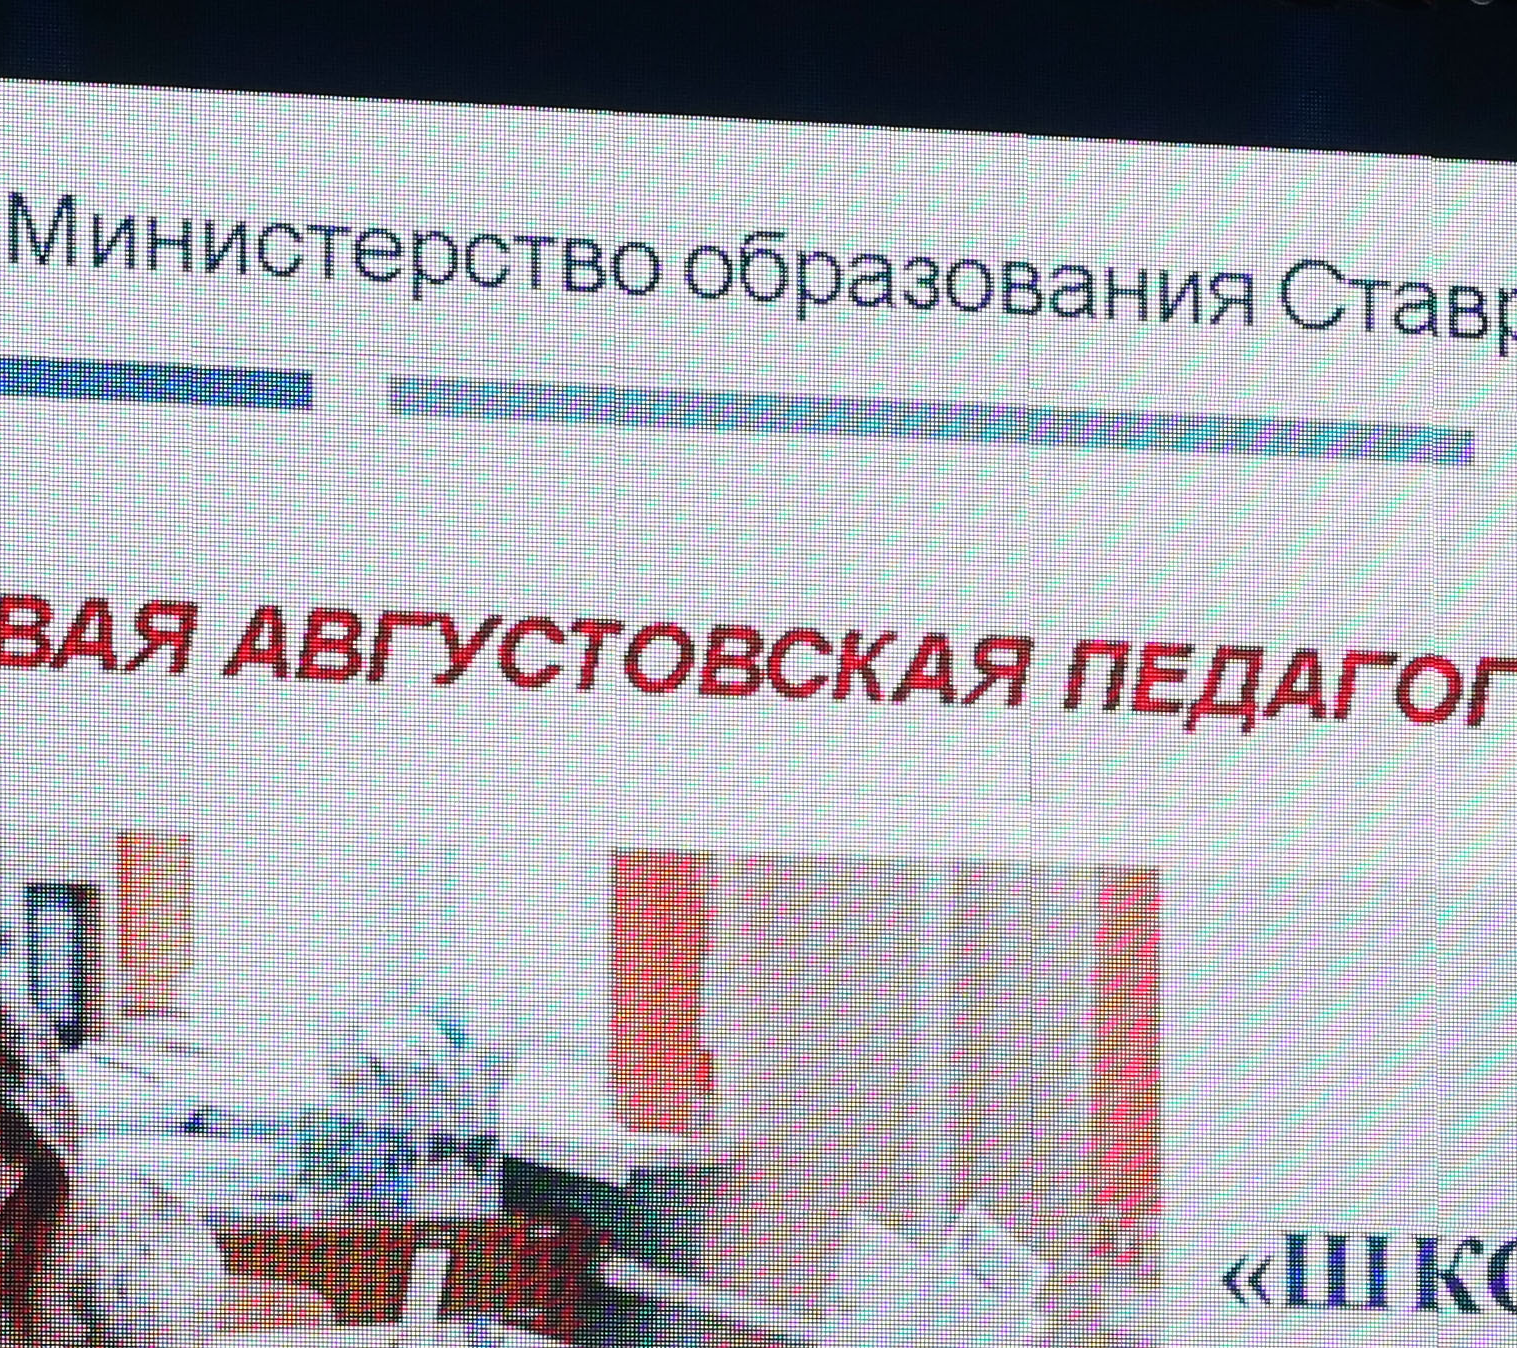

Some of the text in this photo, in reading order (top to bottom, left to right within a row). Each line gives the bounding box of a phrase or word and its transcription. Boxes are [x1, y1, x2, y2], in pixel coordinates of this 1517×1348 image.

[7, 190, 663, 301] Министерство
[683, 229, 1255, 326] образования
[223, 605, 1034, 706] АВГУСТОВСКАЯ
